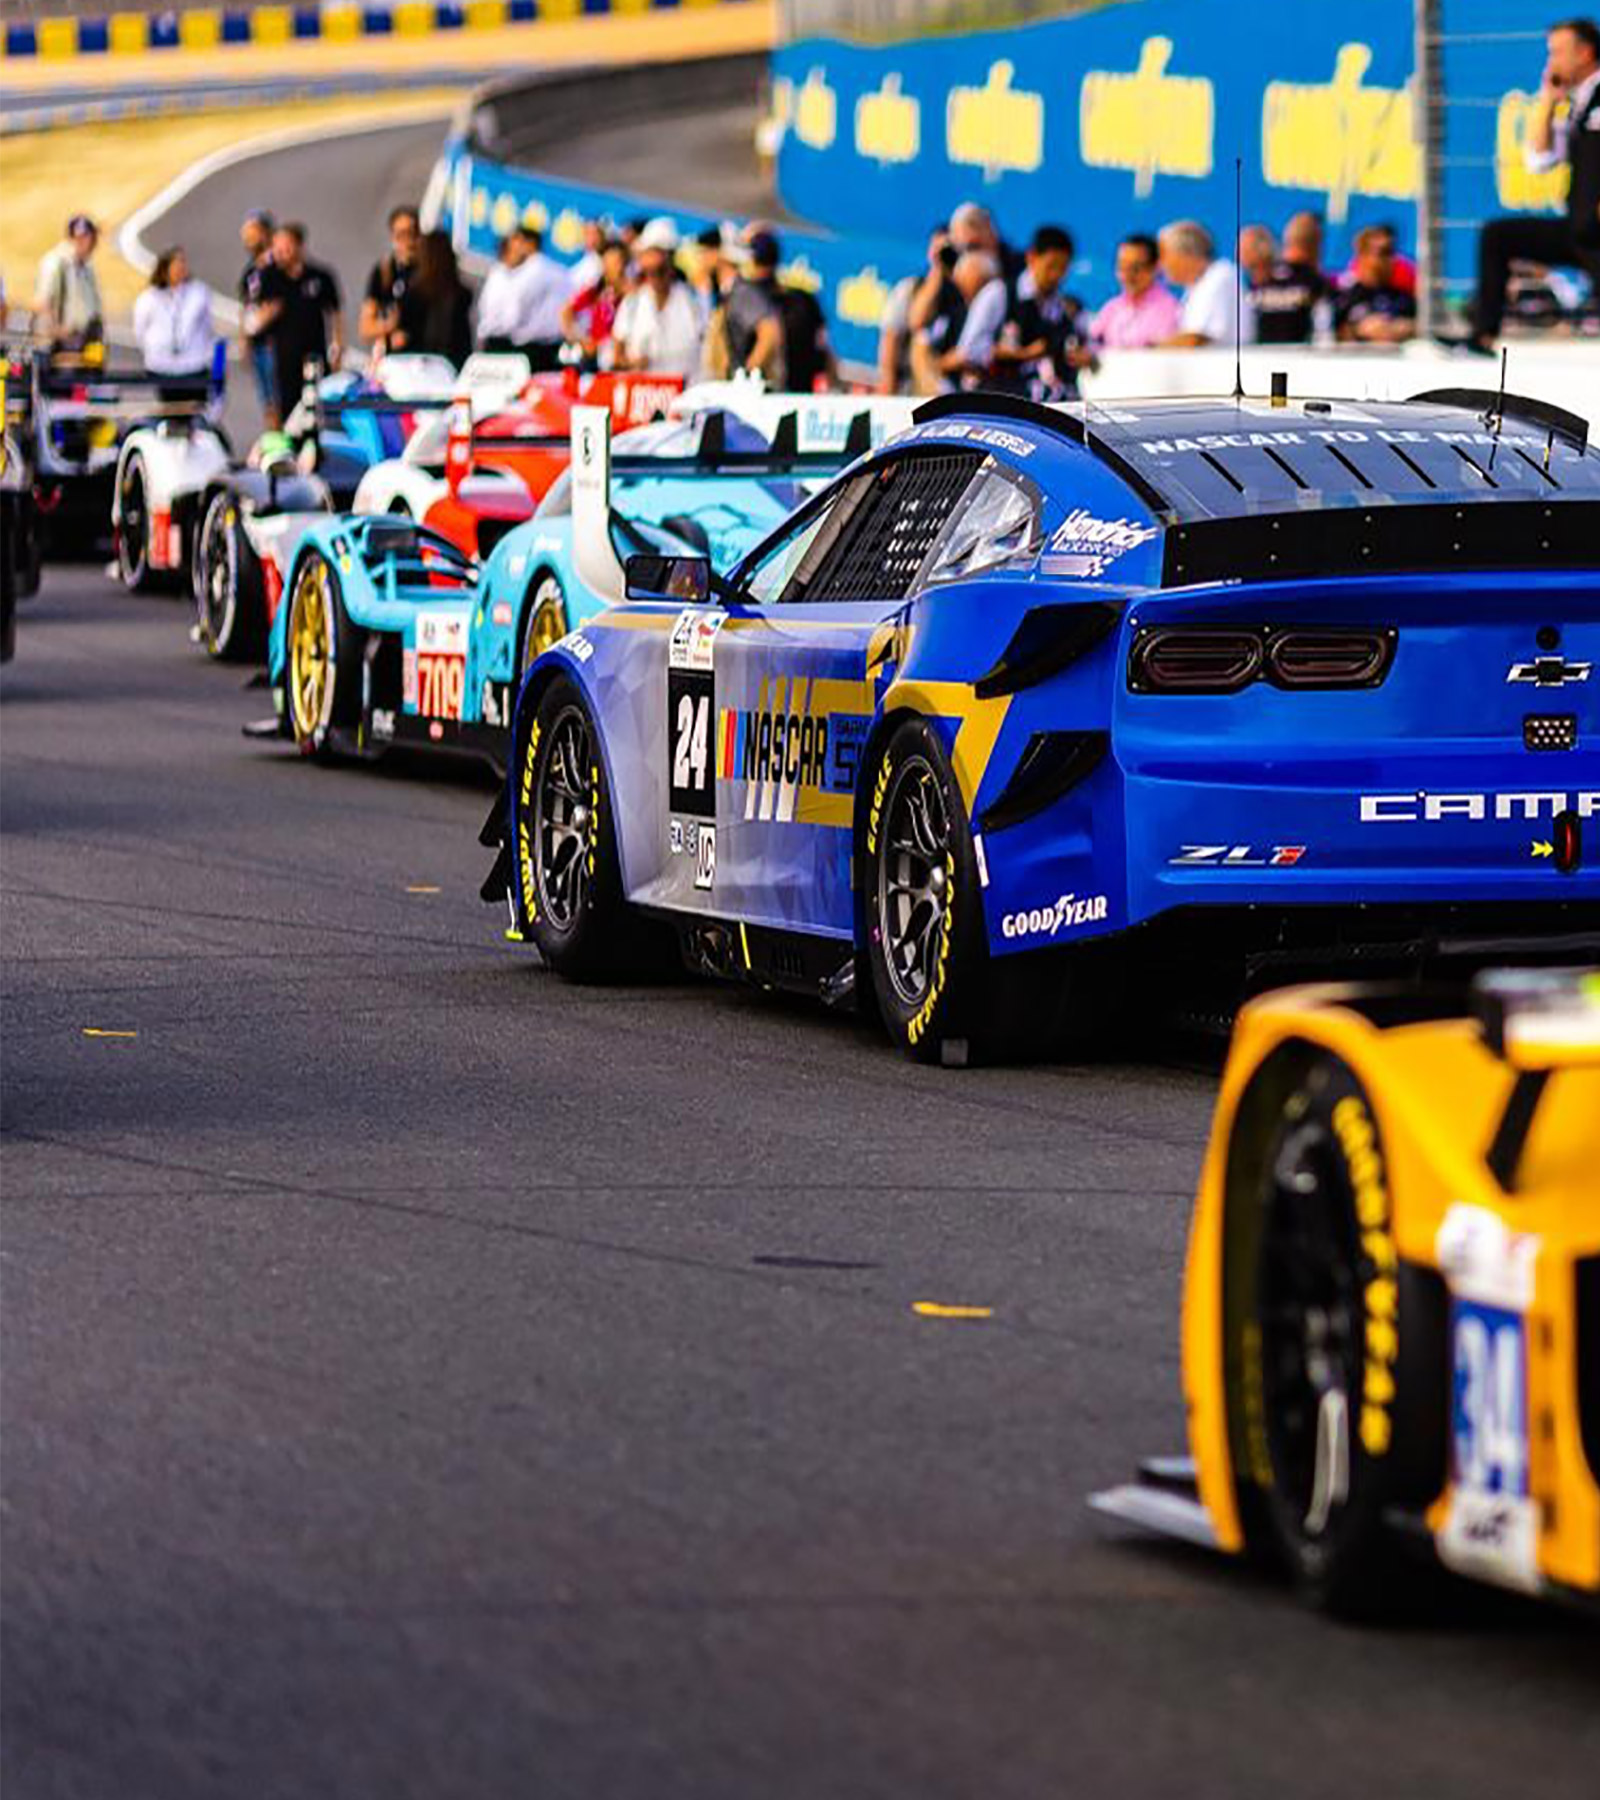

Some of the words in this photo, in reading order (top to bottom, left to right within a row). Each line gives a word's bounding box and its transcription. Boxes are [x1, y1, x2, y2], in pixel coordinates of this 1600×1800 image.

[1141, 431, 1305, 455] NASCAR
[1309, 430, 1369, 443] TO
[1378, 430, 1429, 443] LE
[417, 655, 463, 720] 709
[673, 695, 709, 789] 24
[742, 711, 829, 787] NASCAR
[867, 751, 893, 853] EAGLE
[1002, 894, 1107, 936] GOODYEAR
[1454, 1312, 1522, 1498] 34
